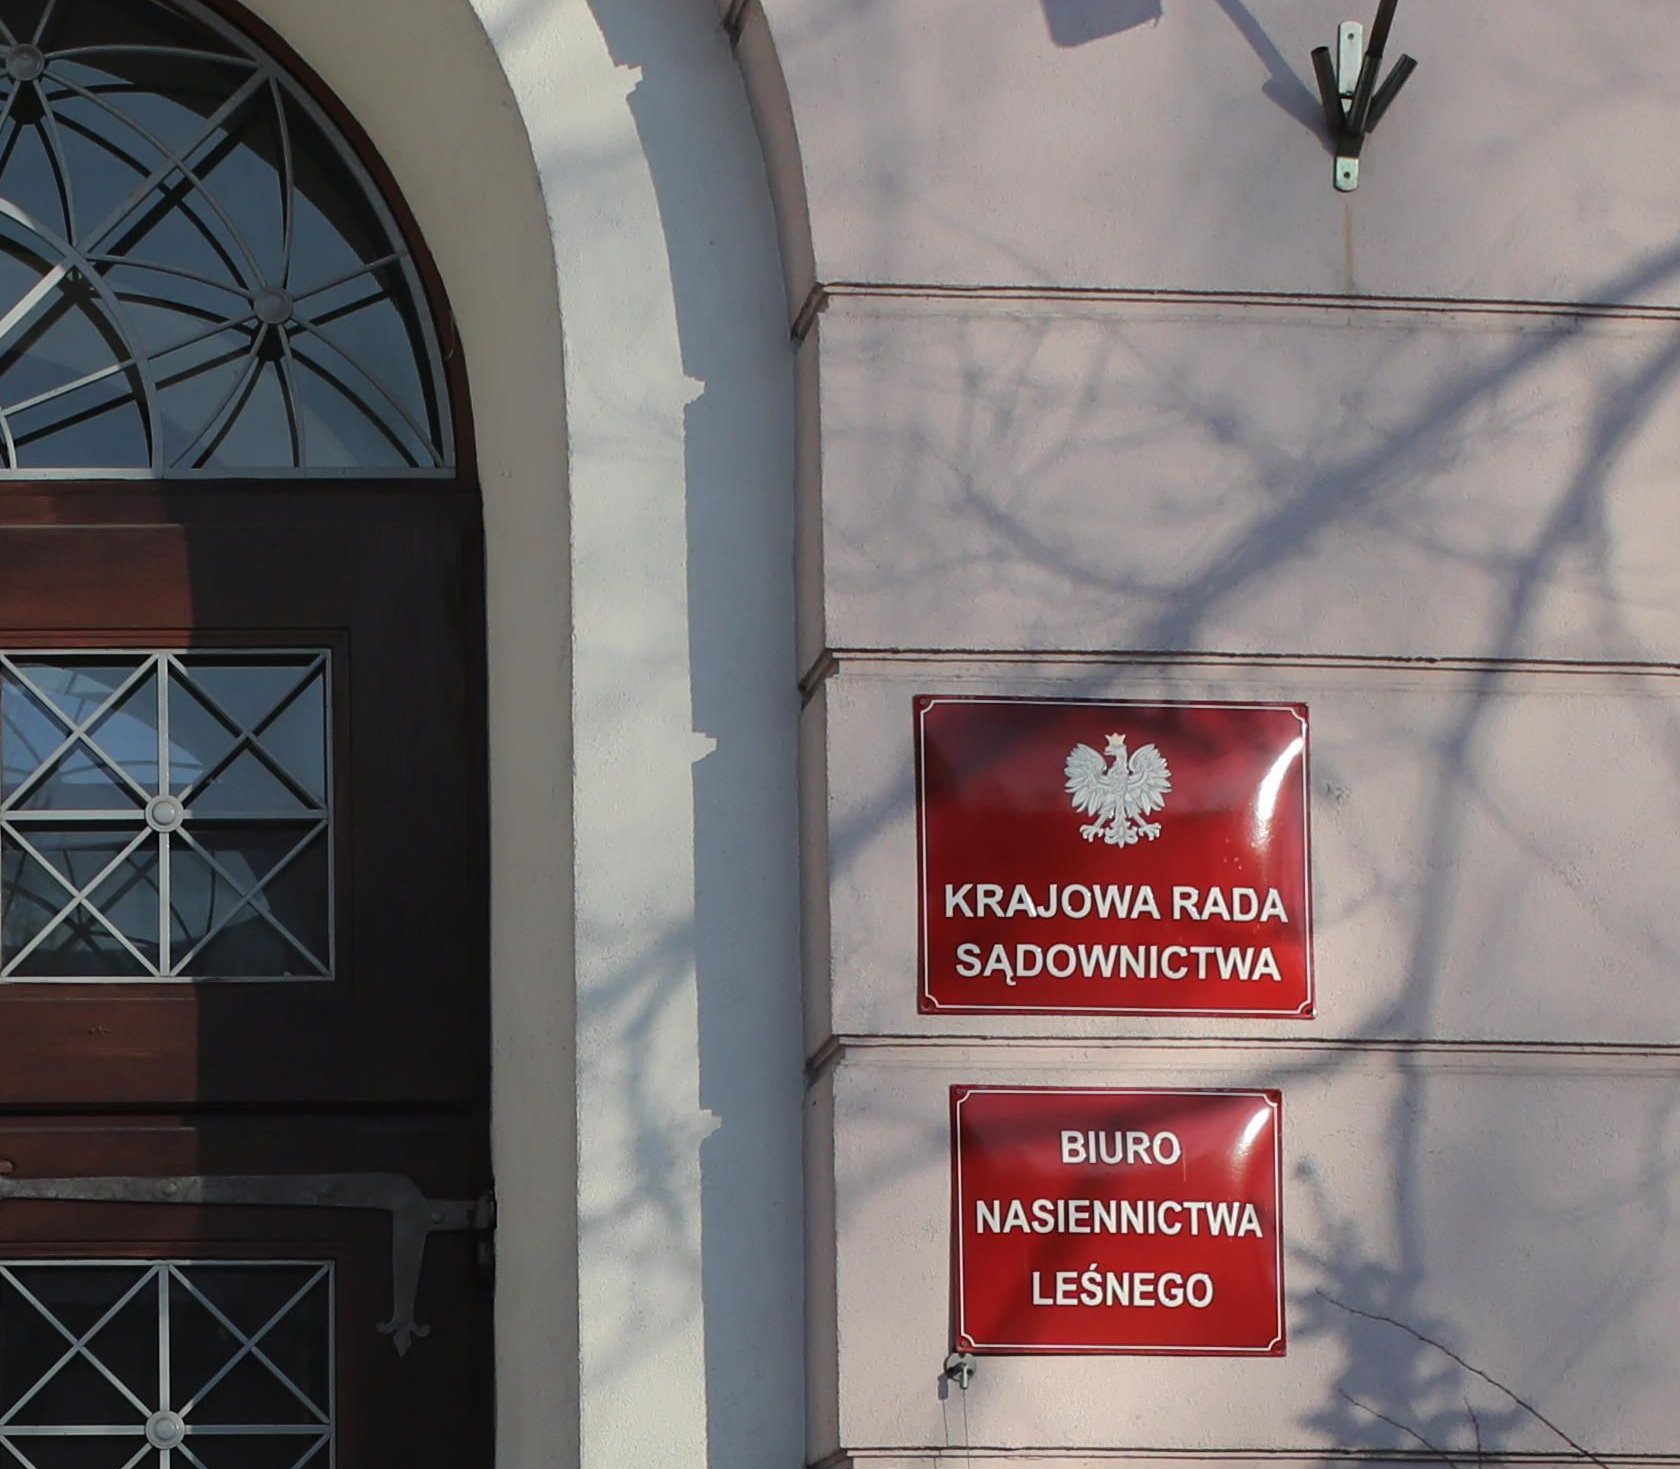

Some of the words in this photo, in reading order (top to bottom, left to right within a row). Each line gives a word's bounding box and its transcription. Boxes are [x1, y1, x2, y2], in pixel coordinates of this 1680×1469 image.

[944, 883, 1161, 920] KRAJOWA
[1172, 886, 1289, 923] RADA
[955, 943, 1283, 986] SĄDOWNICTWA
[1060, 1130, 1181, 1166] BIURO
[976, 1199, 1264, 1238] NASIENNICTWA
[1032, 1263, 1214, 1308] LEŚNEGO
